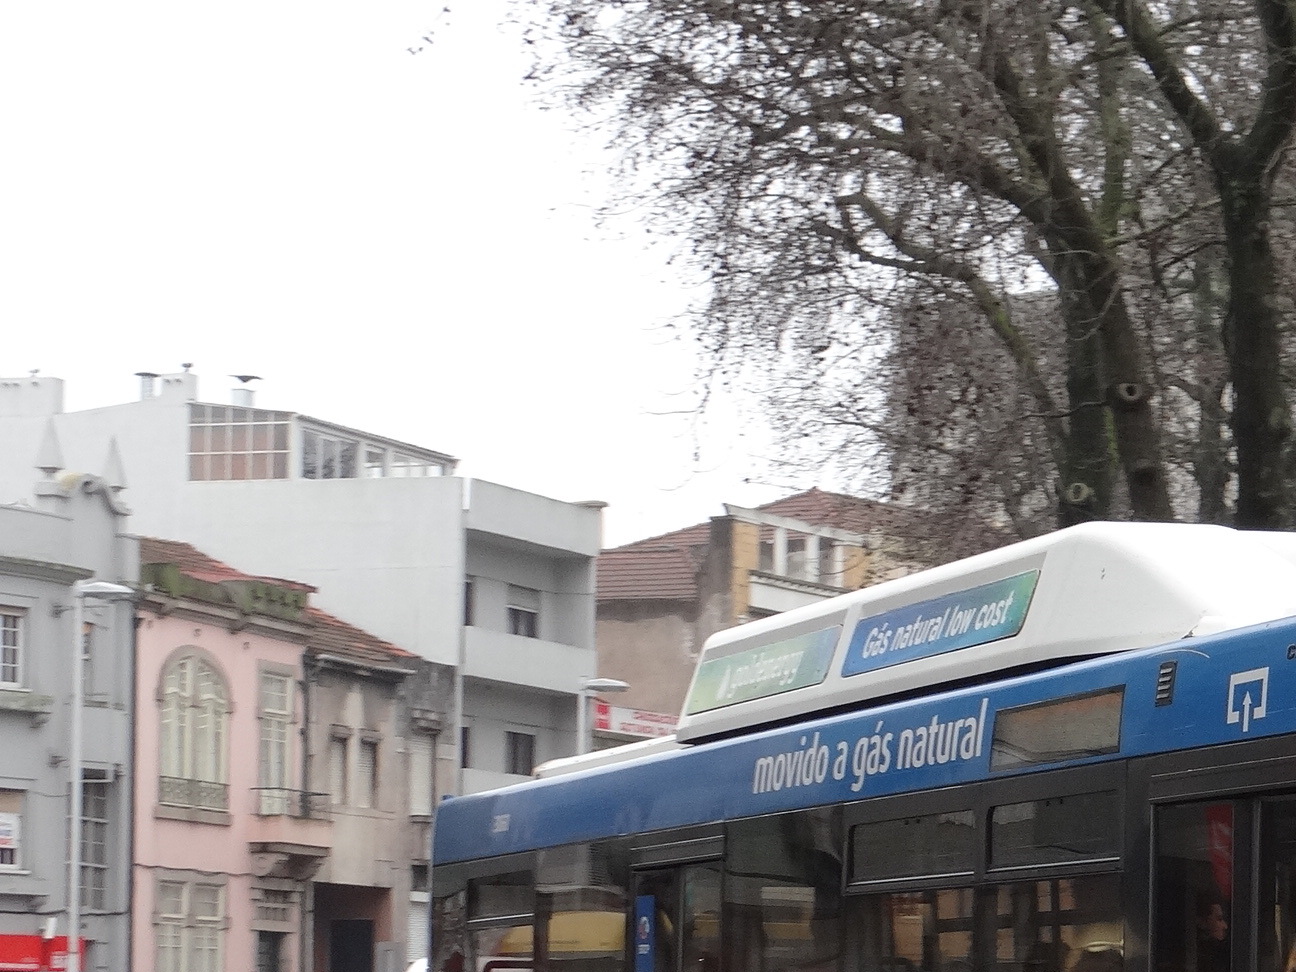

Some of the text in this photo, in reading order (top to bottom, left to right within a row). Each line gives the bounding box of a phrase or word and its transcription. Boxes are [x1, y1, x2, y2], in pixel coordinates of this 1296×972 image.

[862, 590, 1015, 659] Gás natural low cost
[753, 698, 989, 794] movido a gás natural
